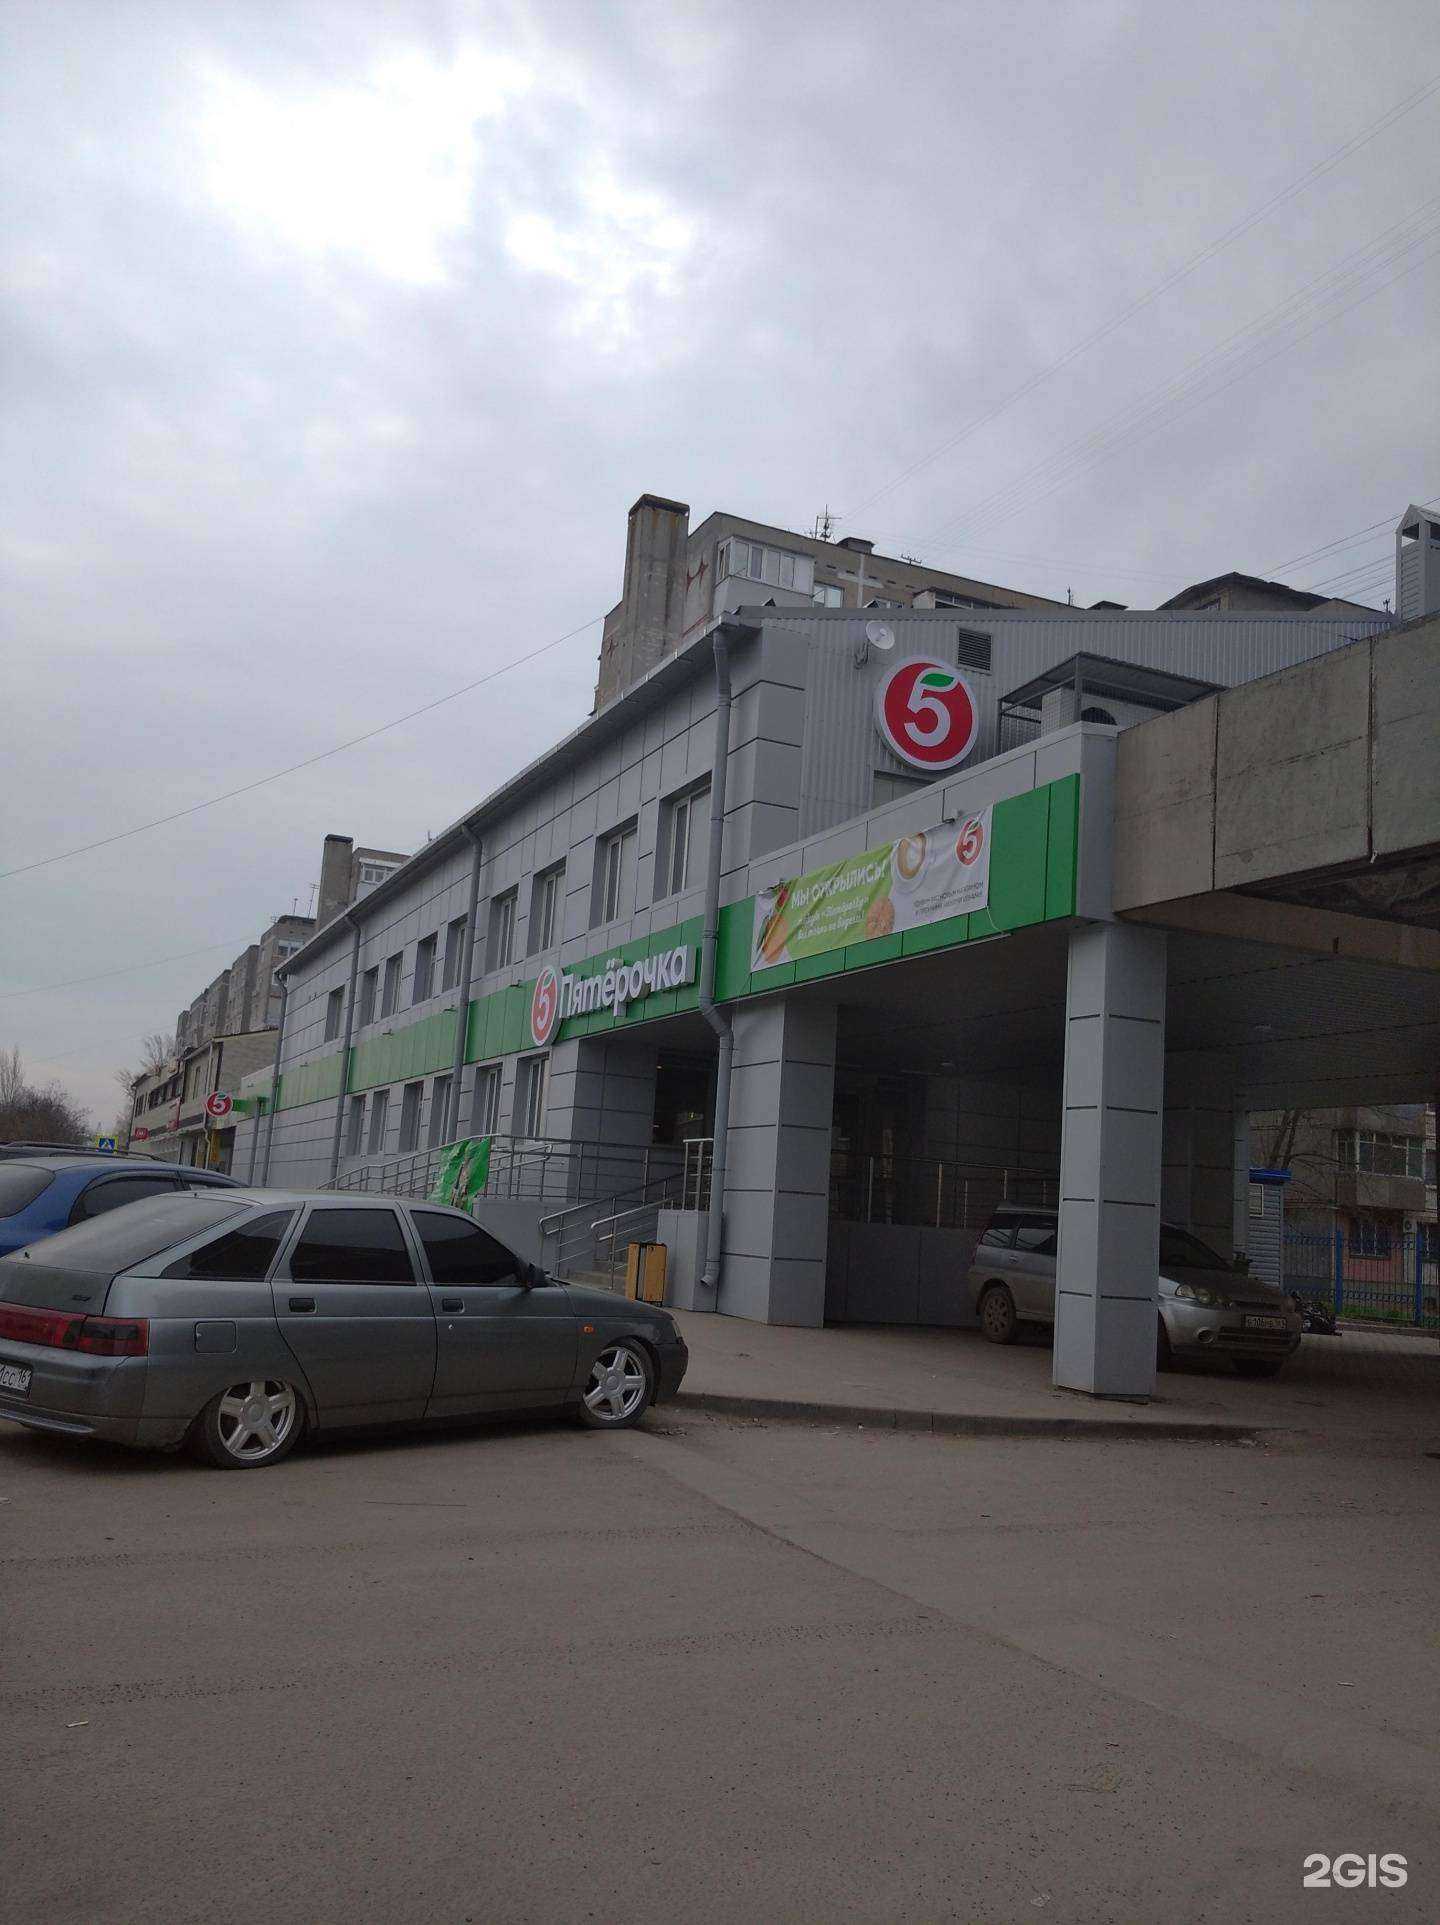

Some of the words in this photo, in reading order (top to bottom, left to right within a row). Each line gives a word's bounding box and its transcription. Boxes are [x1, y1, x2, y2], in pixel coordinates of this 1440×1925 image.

[903, 667, 959, 748] 5
[791, 886, 810, 909] МЫ
[536, 969, 557, 1030] 5
[558, 944, 690, 1018] Пятёрочка
